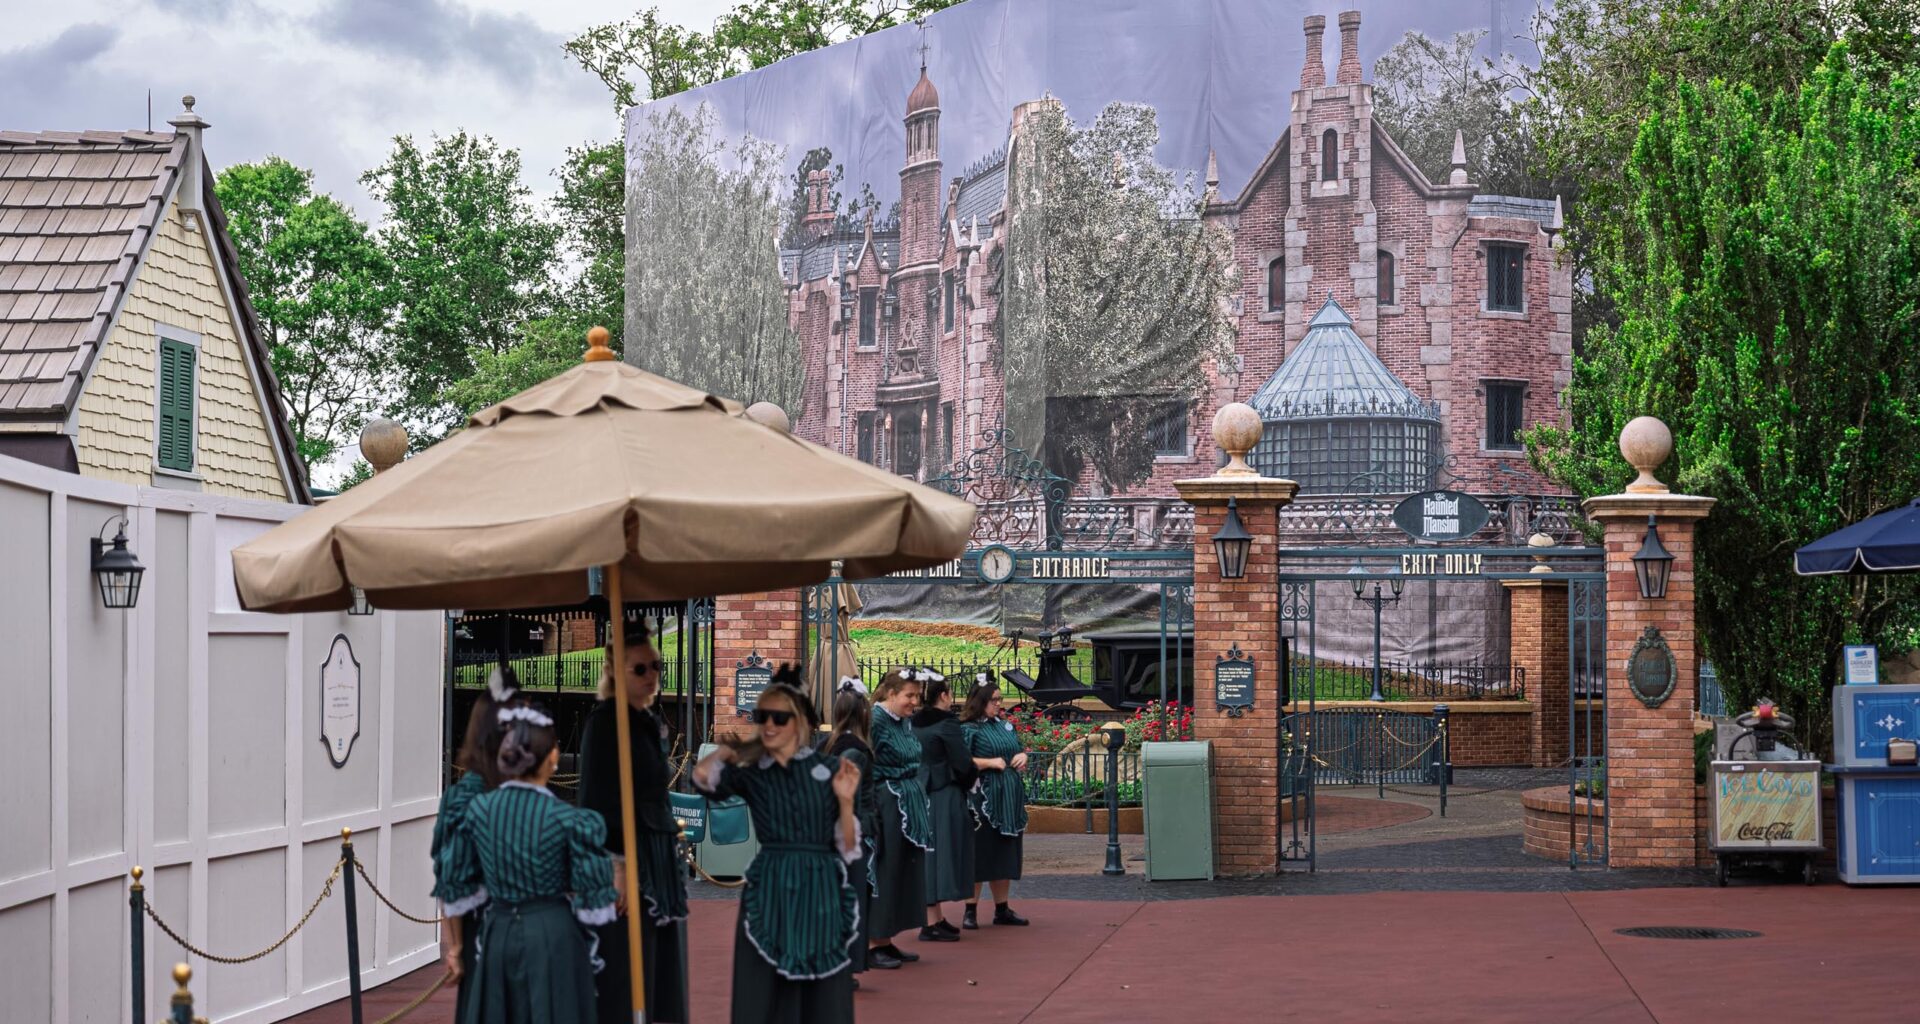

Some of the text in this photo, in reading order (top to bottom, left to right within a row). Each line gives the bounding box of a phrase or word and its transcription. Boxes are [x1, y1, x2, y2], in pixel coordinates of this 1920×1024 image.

[1423, 497, 1459, 516] Haunted
[1422, 516, 1459, 536] Mansion
[1032, 557, 1110, 579] ENTRANCE
[1402, 553, 1482, 575] EXIT ONLY
[672, 806, 701, 817] STANDBY
[673, 815, 703, 827] ANCE
[1738, 822, 1794, 841] Coca-Cola
